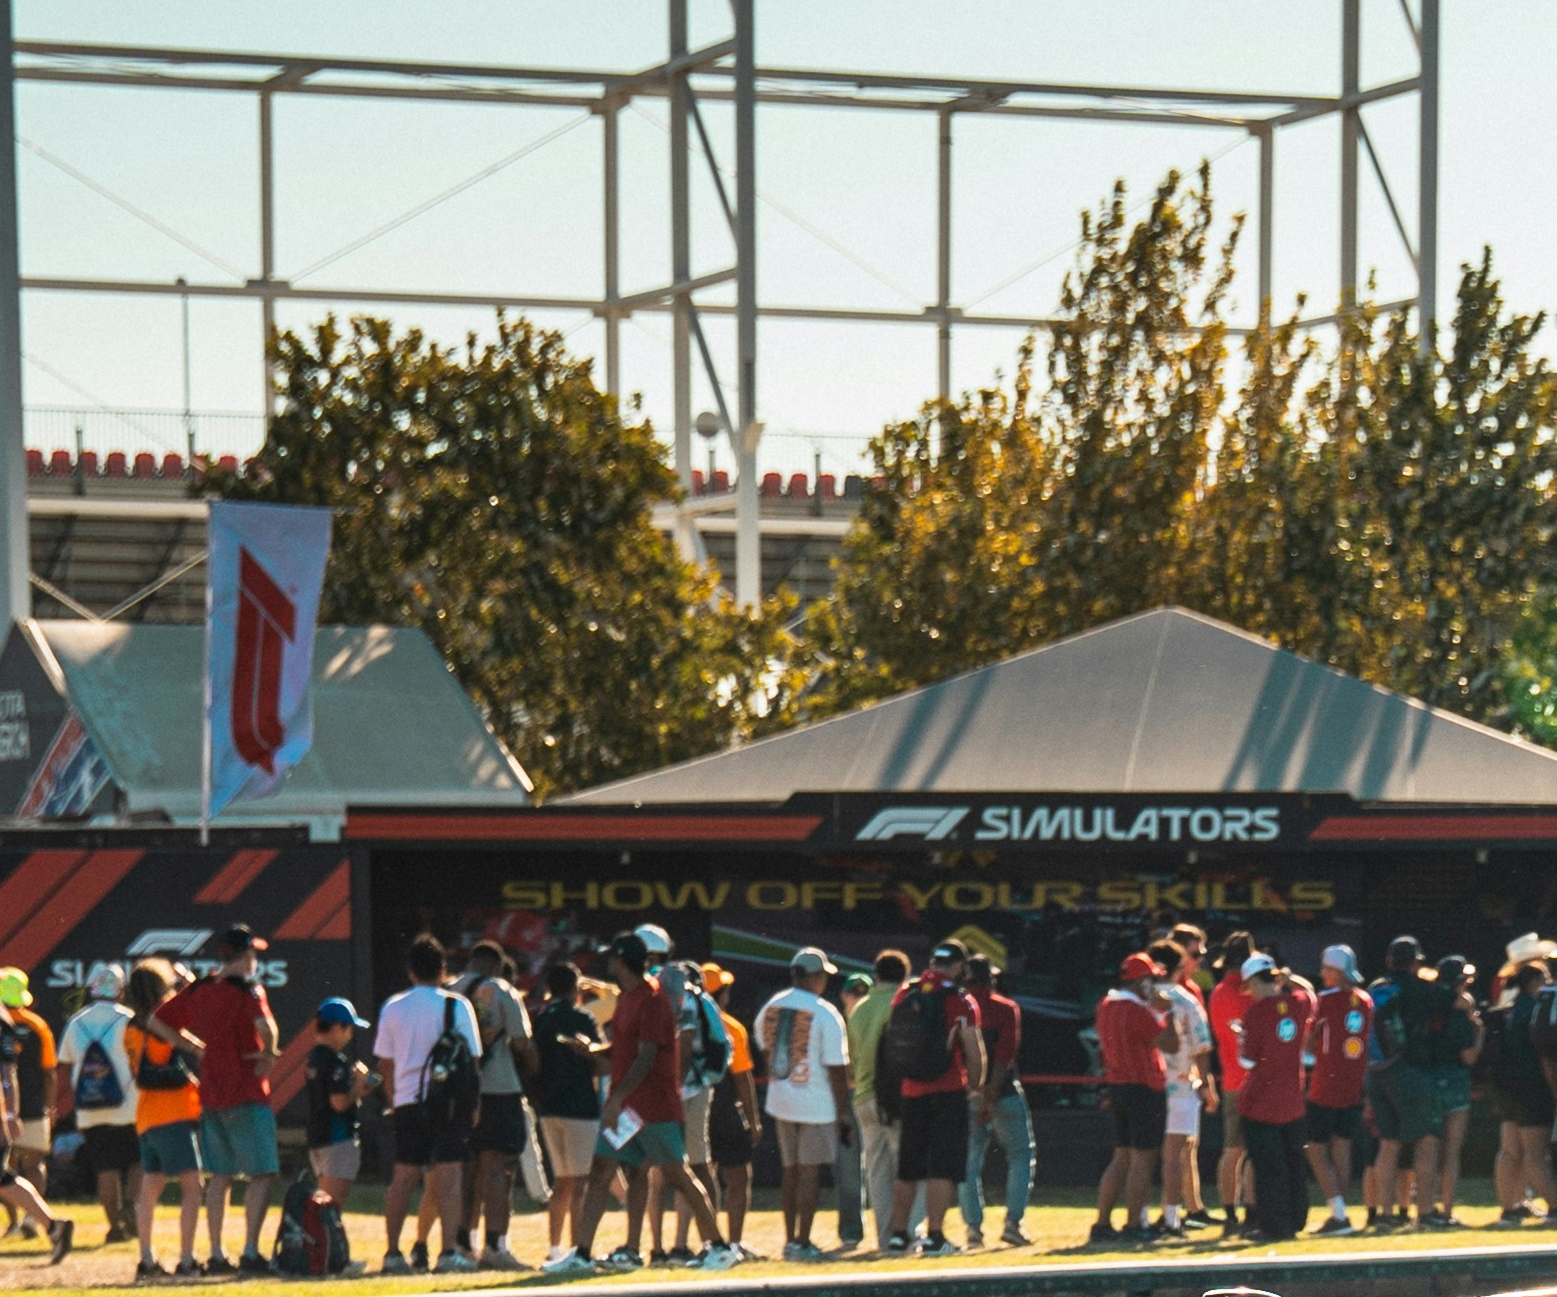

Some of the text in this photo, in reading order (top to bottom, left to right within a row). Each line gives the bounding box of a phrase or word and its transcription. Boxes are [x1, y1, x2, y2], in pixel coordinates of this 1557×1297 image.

[854, 806, 1281, 842] F1 SIMULATORS
[501, 880, 1336, 912] SHOW OFF YOUR SKILLS
